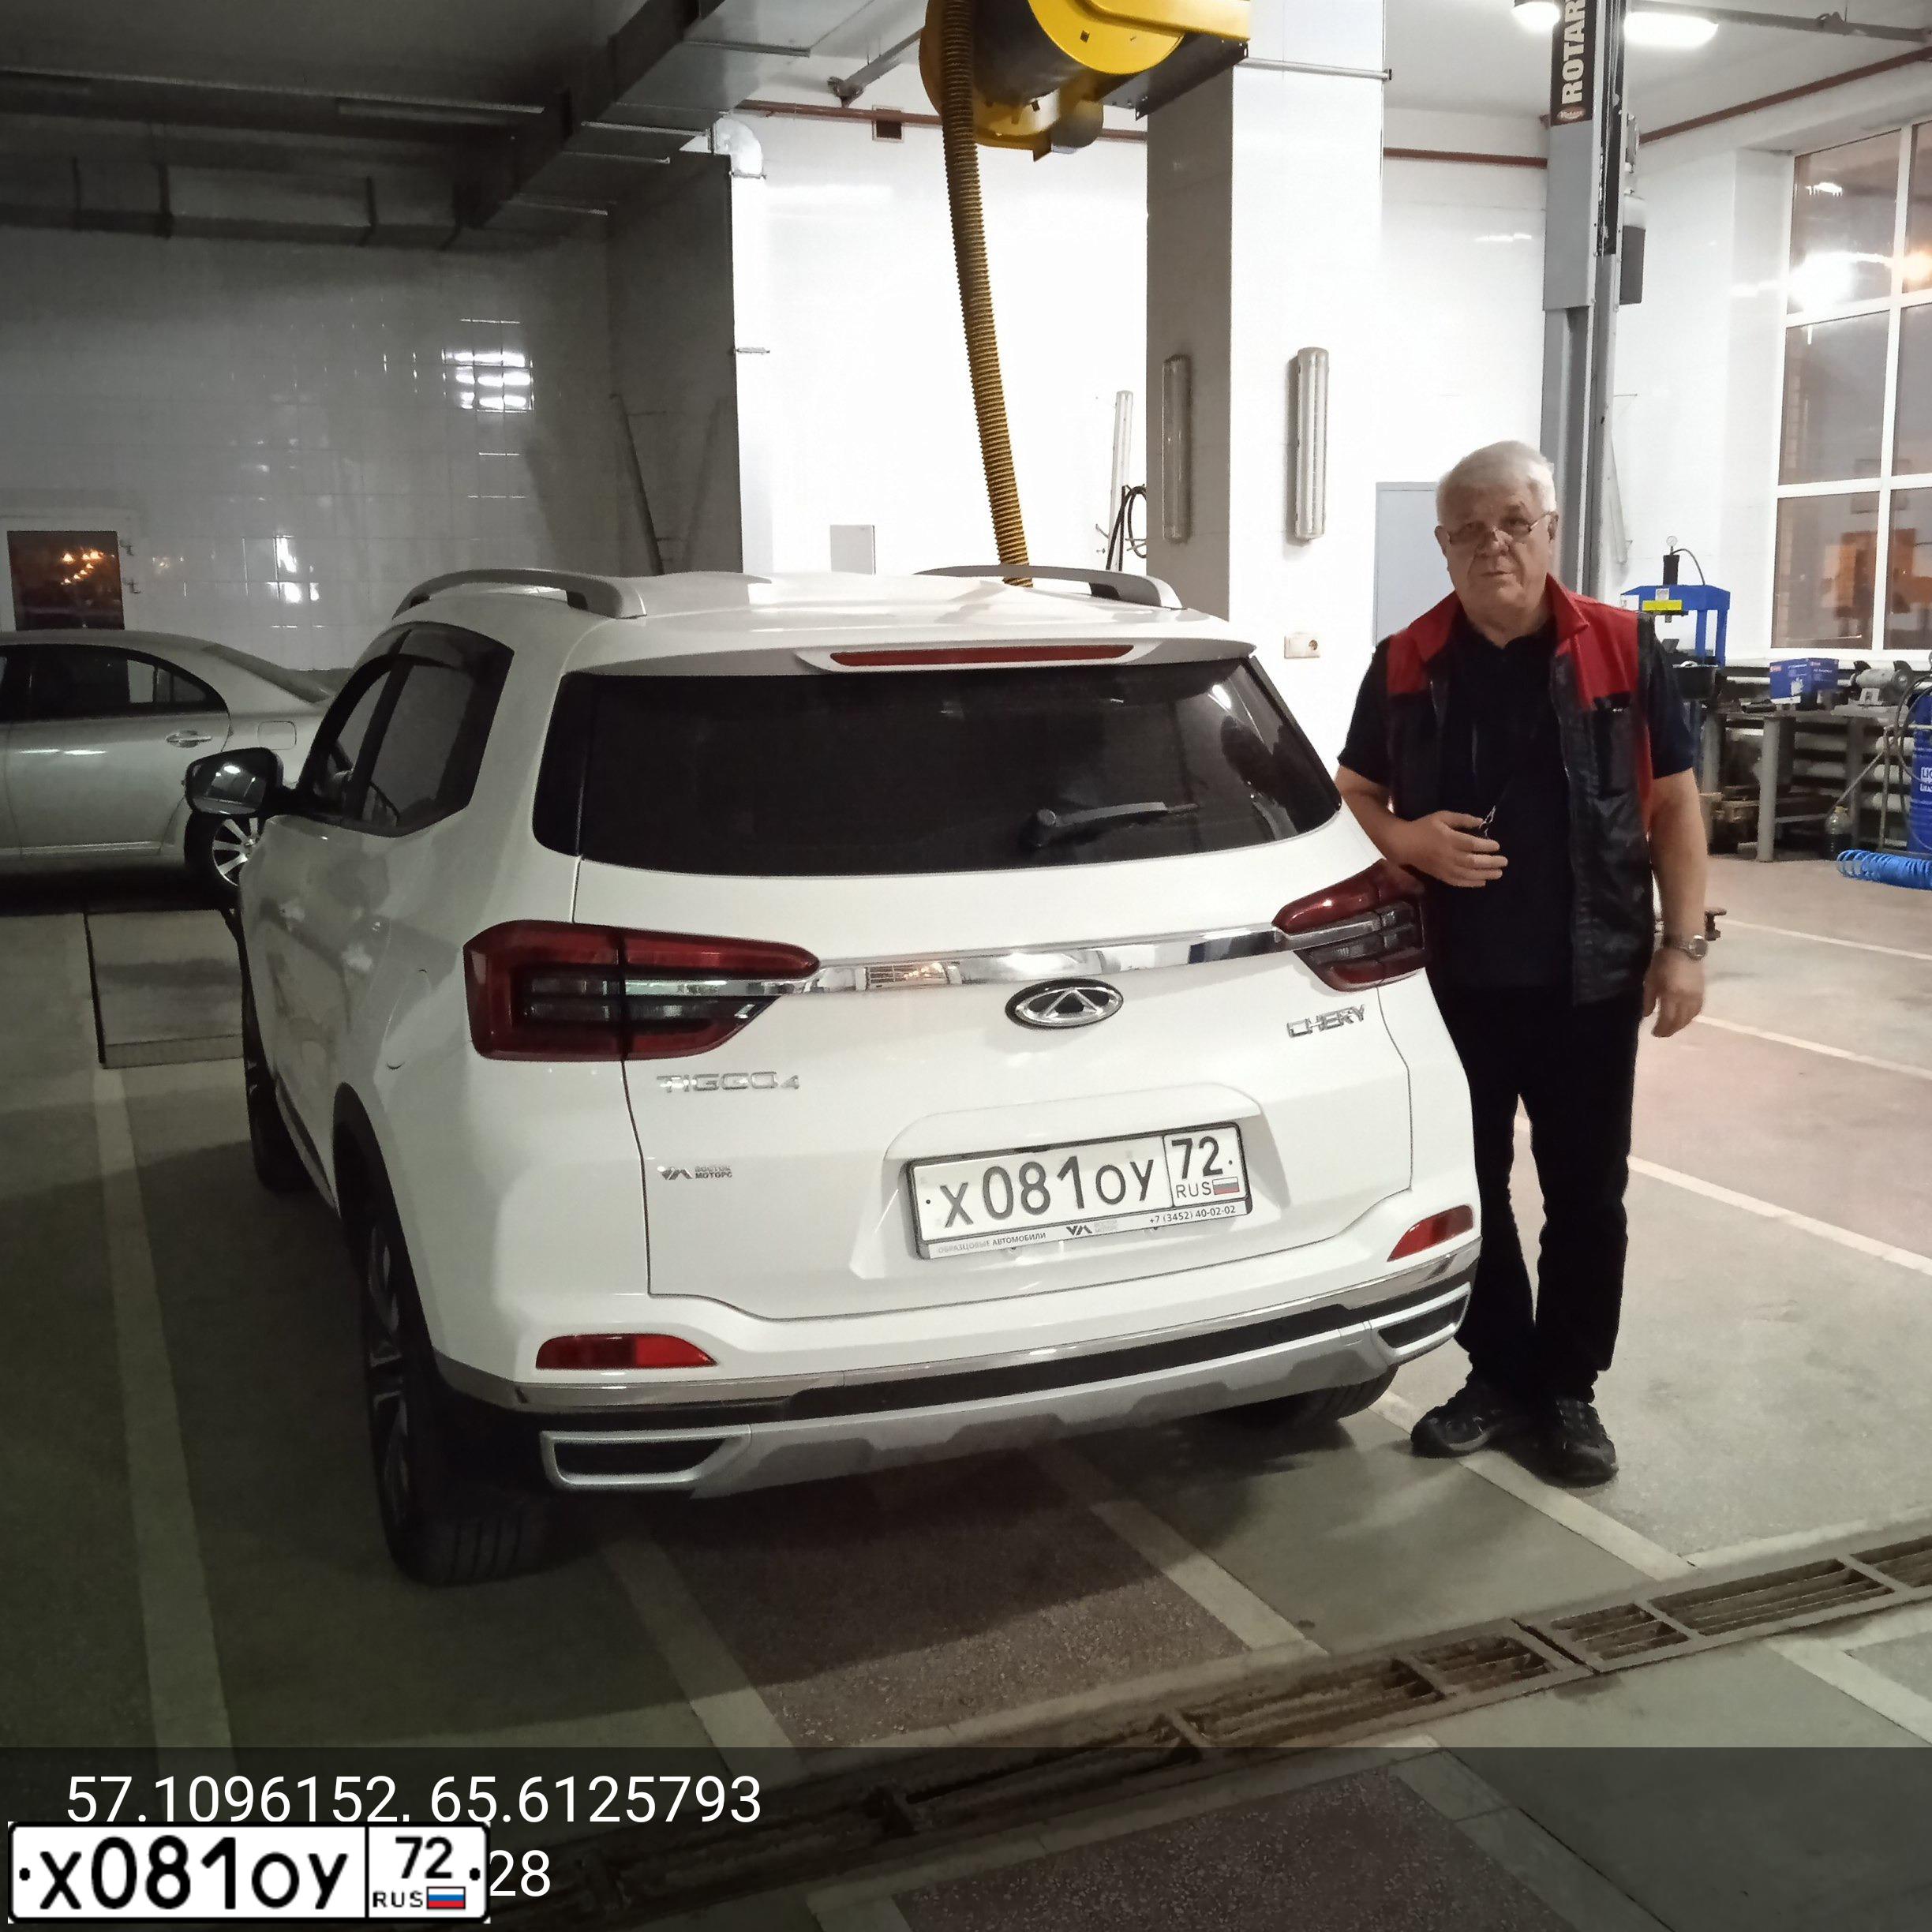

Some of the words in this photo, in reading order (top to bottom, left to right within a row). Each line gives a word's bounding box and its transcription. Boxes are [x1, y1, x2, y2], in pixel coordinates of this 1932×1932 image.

[1562, 0, 1586, 104] ROTAR
[1286, 1004, 1365, 1038] CHERY
[1172, 1135, 1223, 1180] 72
[1176, 1182, 1212, 1199] RUS
[1149, 1215, 1160, 1224] +7
[1163, 1211, 1193, 1222] (3452)
[1195, 1205, 1237, 1219] 40-02-02
[992, 1232, 1046, 1247] АВТОМОБИЛИ
